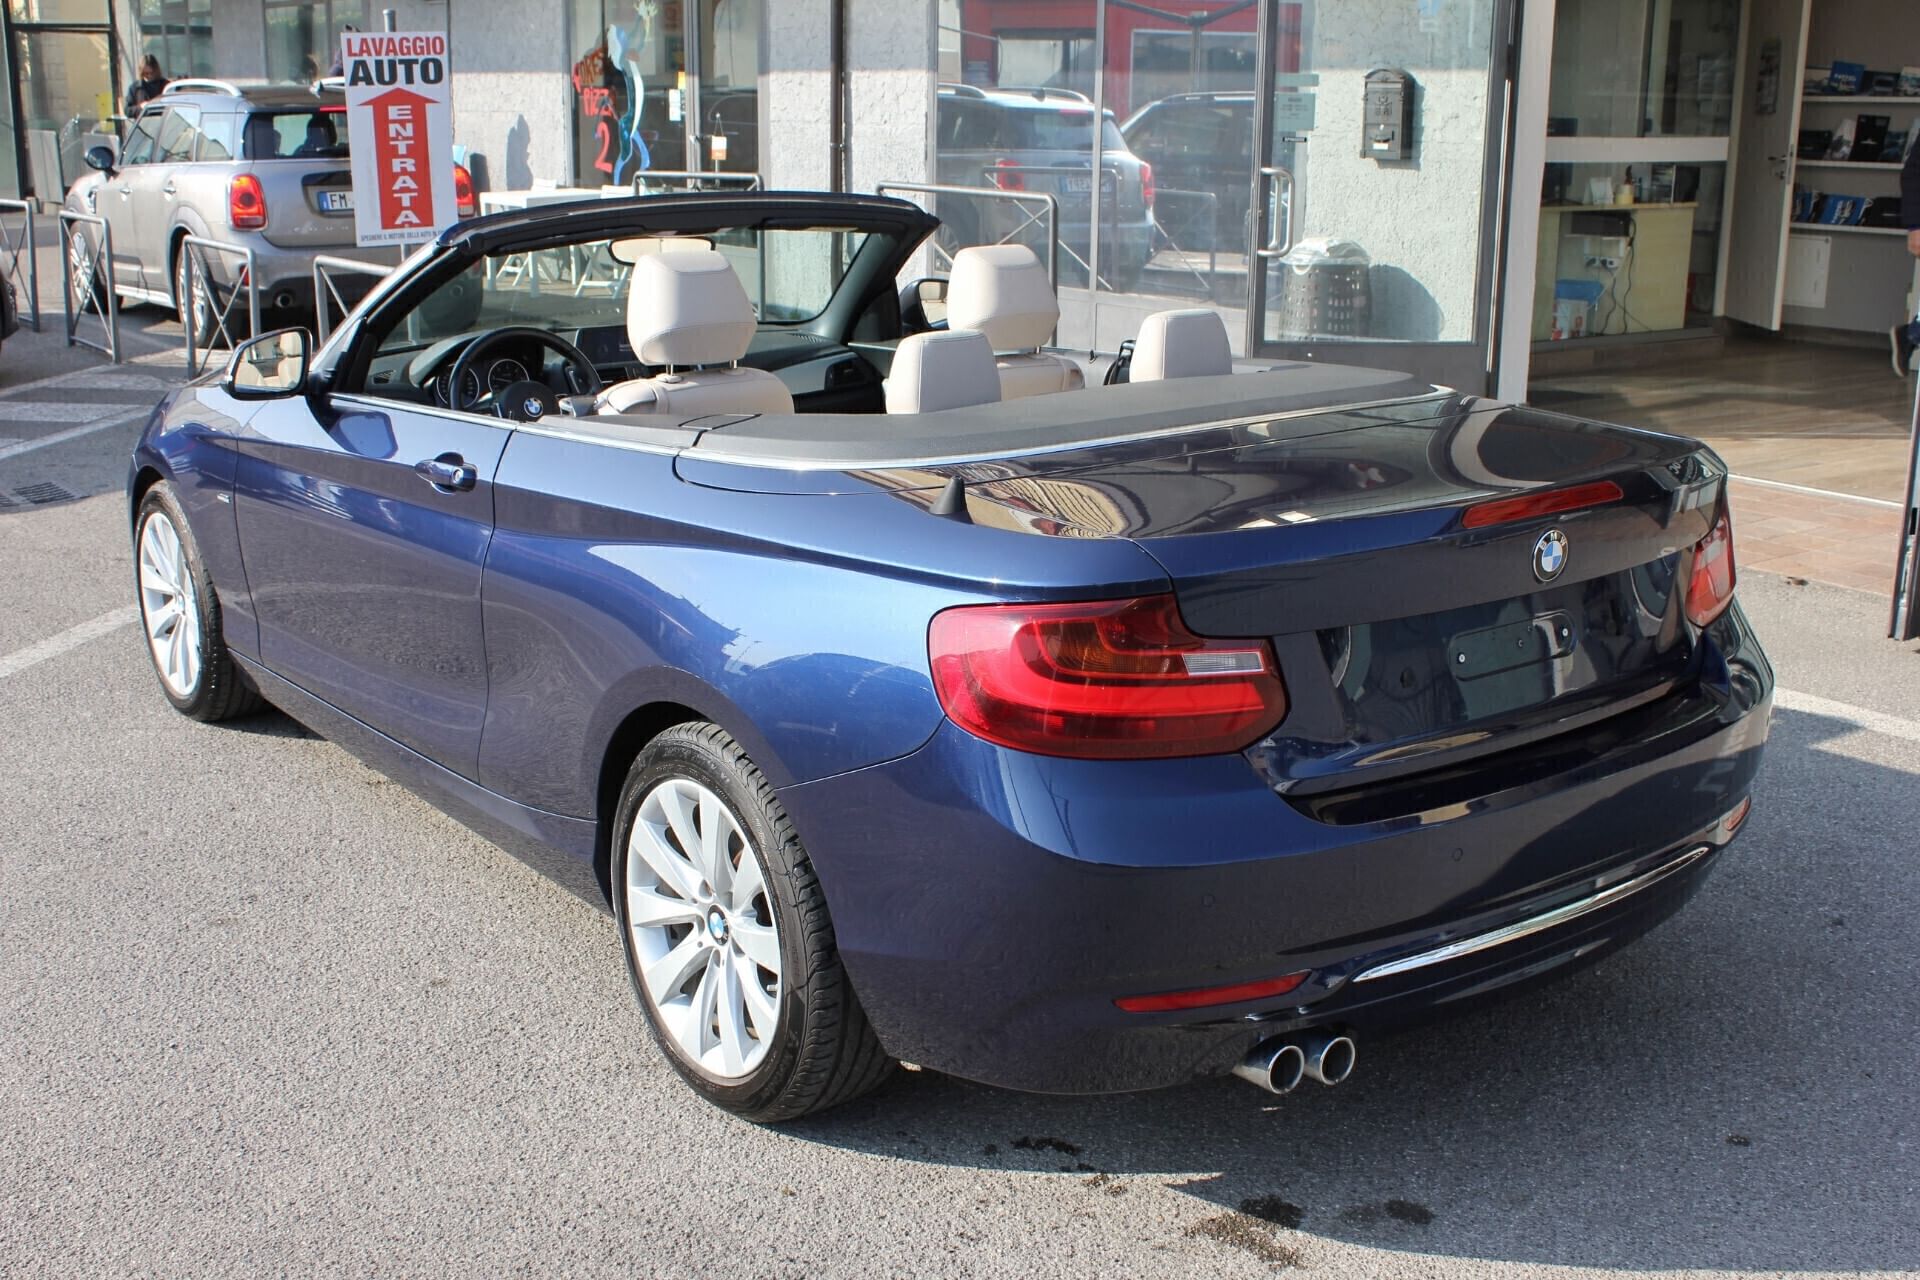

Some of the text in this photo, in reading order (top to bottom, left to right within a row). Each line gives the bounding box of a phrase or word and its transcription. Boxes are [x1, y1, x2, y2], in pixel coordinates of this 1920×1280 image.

[346, 36, 445, 57] LAVAGGIO
[349, 58, 443, 87] AUTO
[594, 121, 613, 173] 2
[388, 105, 421, 225] ENTRATA
[329, 193, 348, 208] FM
